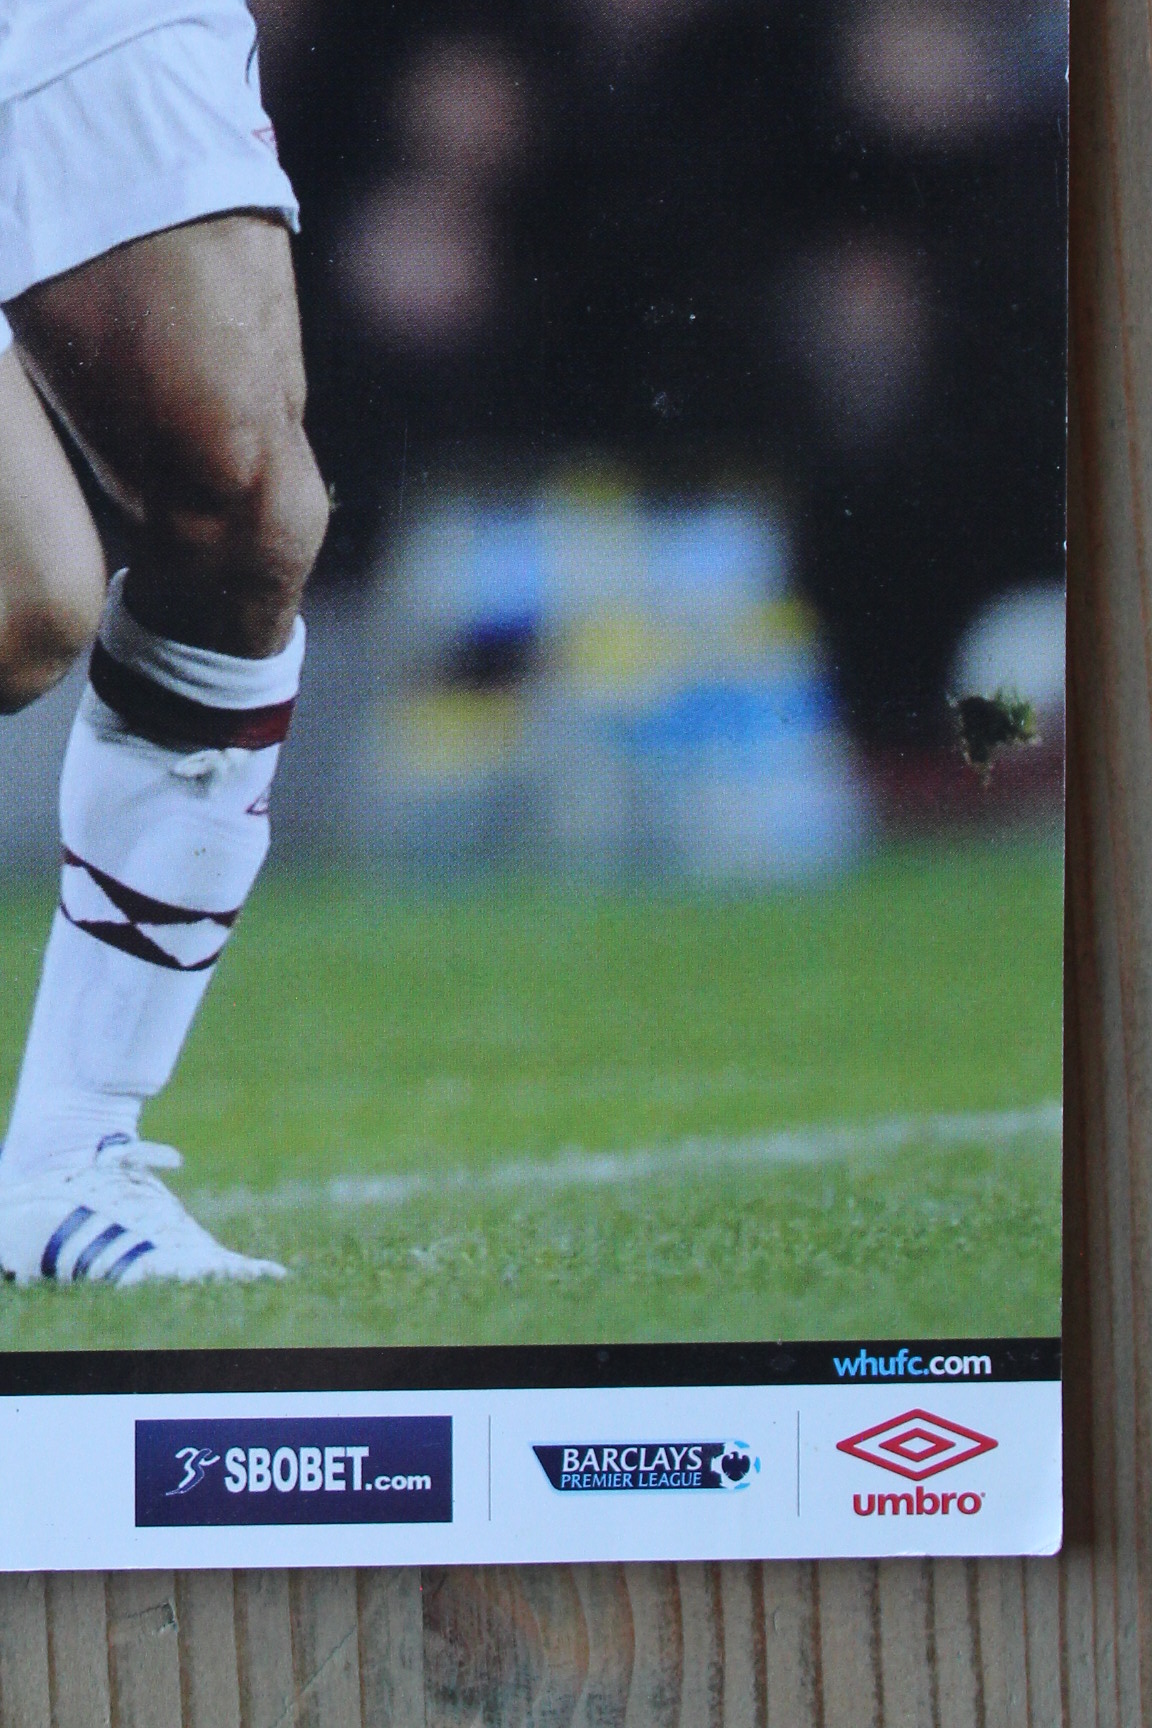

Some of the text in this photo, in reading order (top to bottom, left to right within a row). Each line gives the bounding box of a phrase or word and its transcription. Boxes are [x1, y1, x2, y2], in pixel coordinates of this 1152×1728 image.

[833, 1348, 992, 1377] whufc.com
[224, 1446, 432, 1494] SBOBET.com
[562, 1446, 703, 1472] BARCLAYS
[561, 1471, 702, 1489] PREMIER LEAGUE
[853, 1486, 982, 1517] umbro
